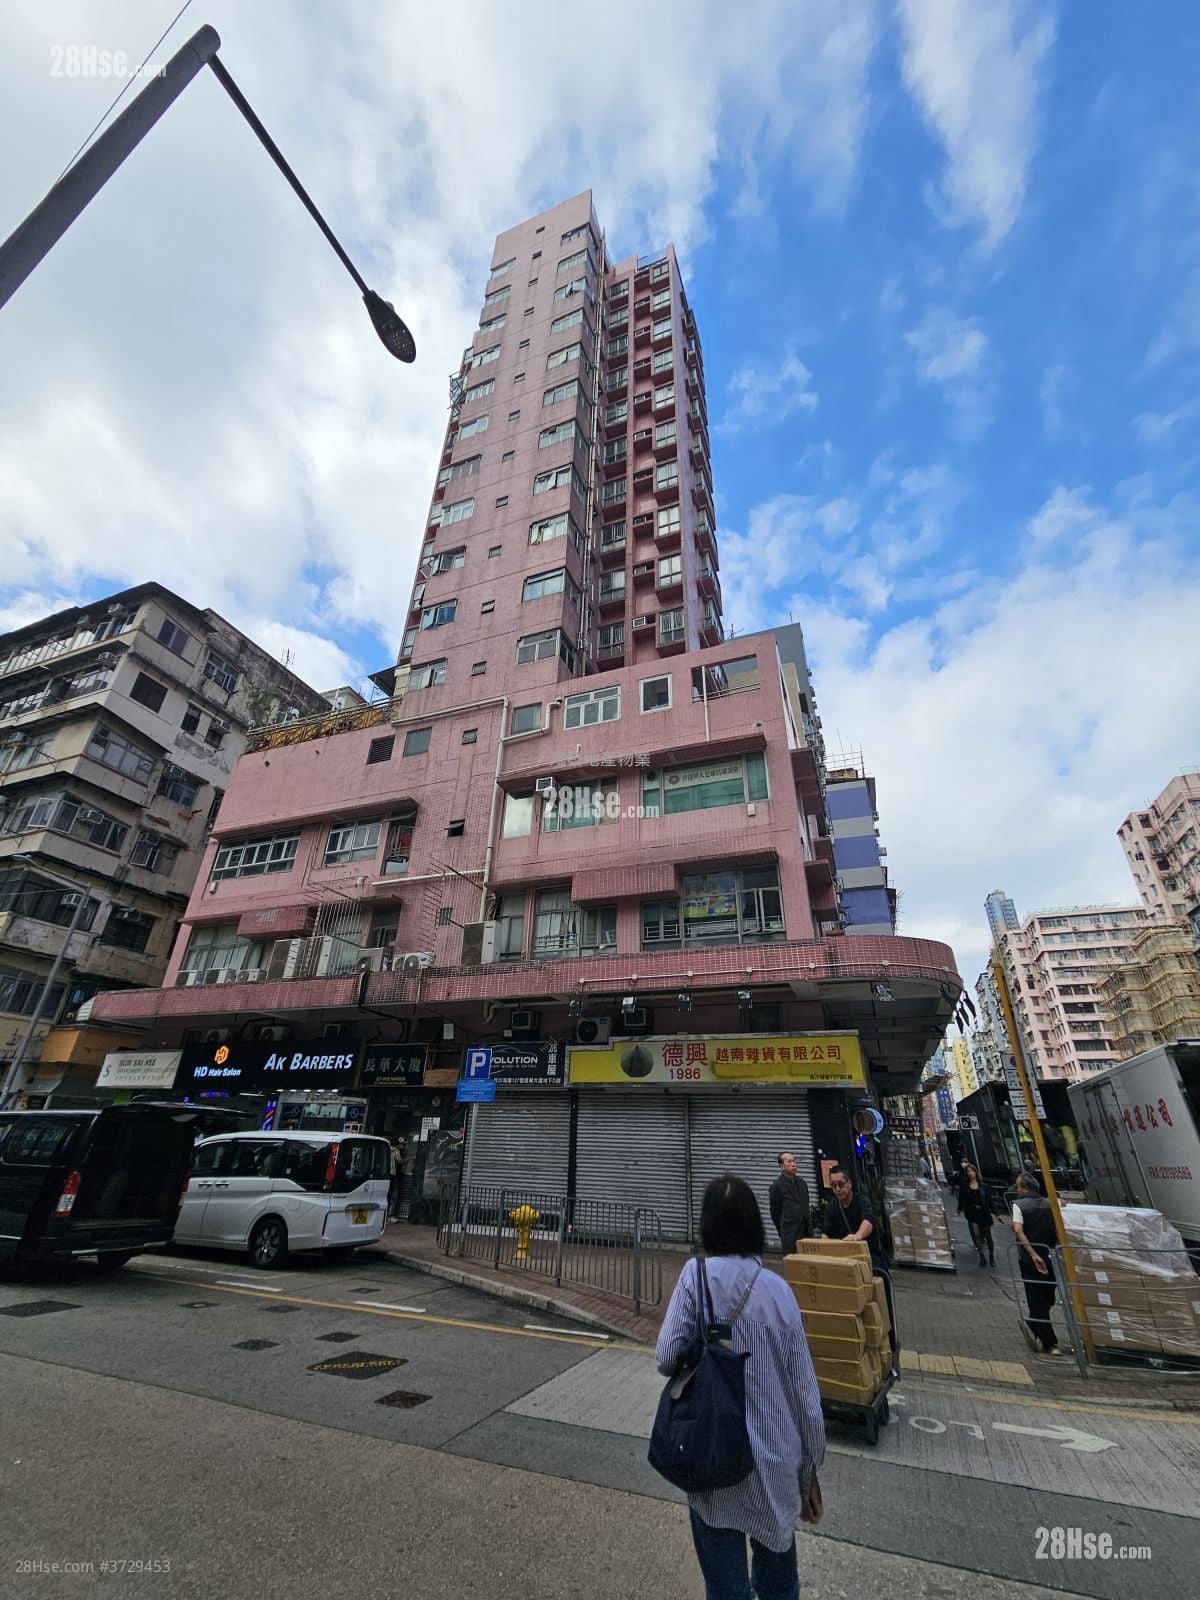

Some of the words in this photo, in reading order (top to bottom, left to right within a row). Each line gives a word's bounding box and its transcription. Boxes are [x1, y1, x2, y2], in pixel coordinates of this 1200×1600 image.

[289, 1052, 354, 1071] BARBERS
[546, 1043, 558, 1076] 洗車屋
[661, 1042, 708, 1067] 德興
[715, 1045, 842, 1062] 越南雜貨有限公司
[194, 1066, 208, 1078] HD
[208, 1068, 222, 1077] Hair
[222, 1067, 241, 1077] Salon
[364, 1056, 422, 1073] 長華大廈
[470, 1052, 487, 1077] P
[669, 1068, 701, 1080] 1986
